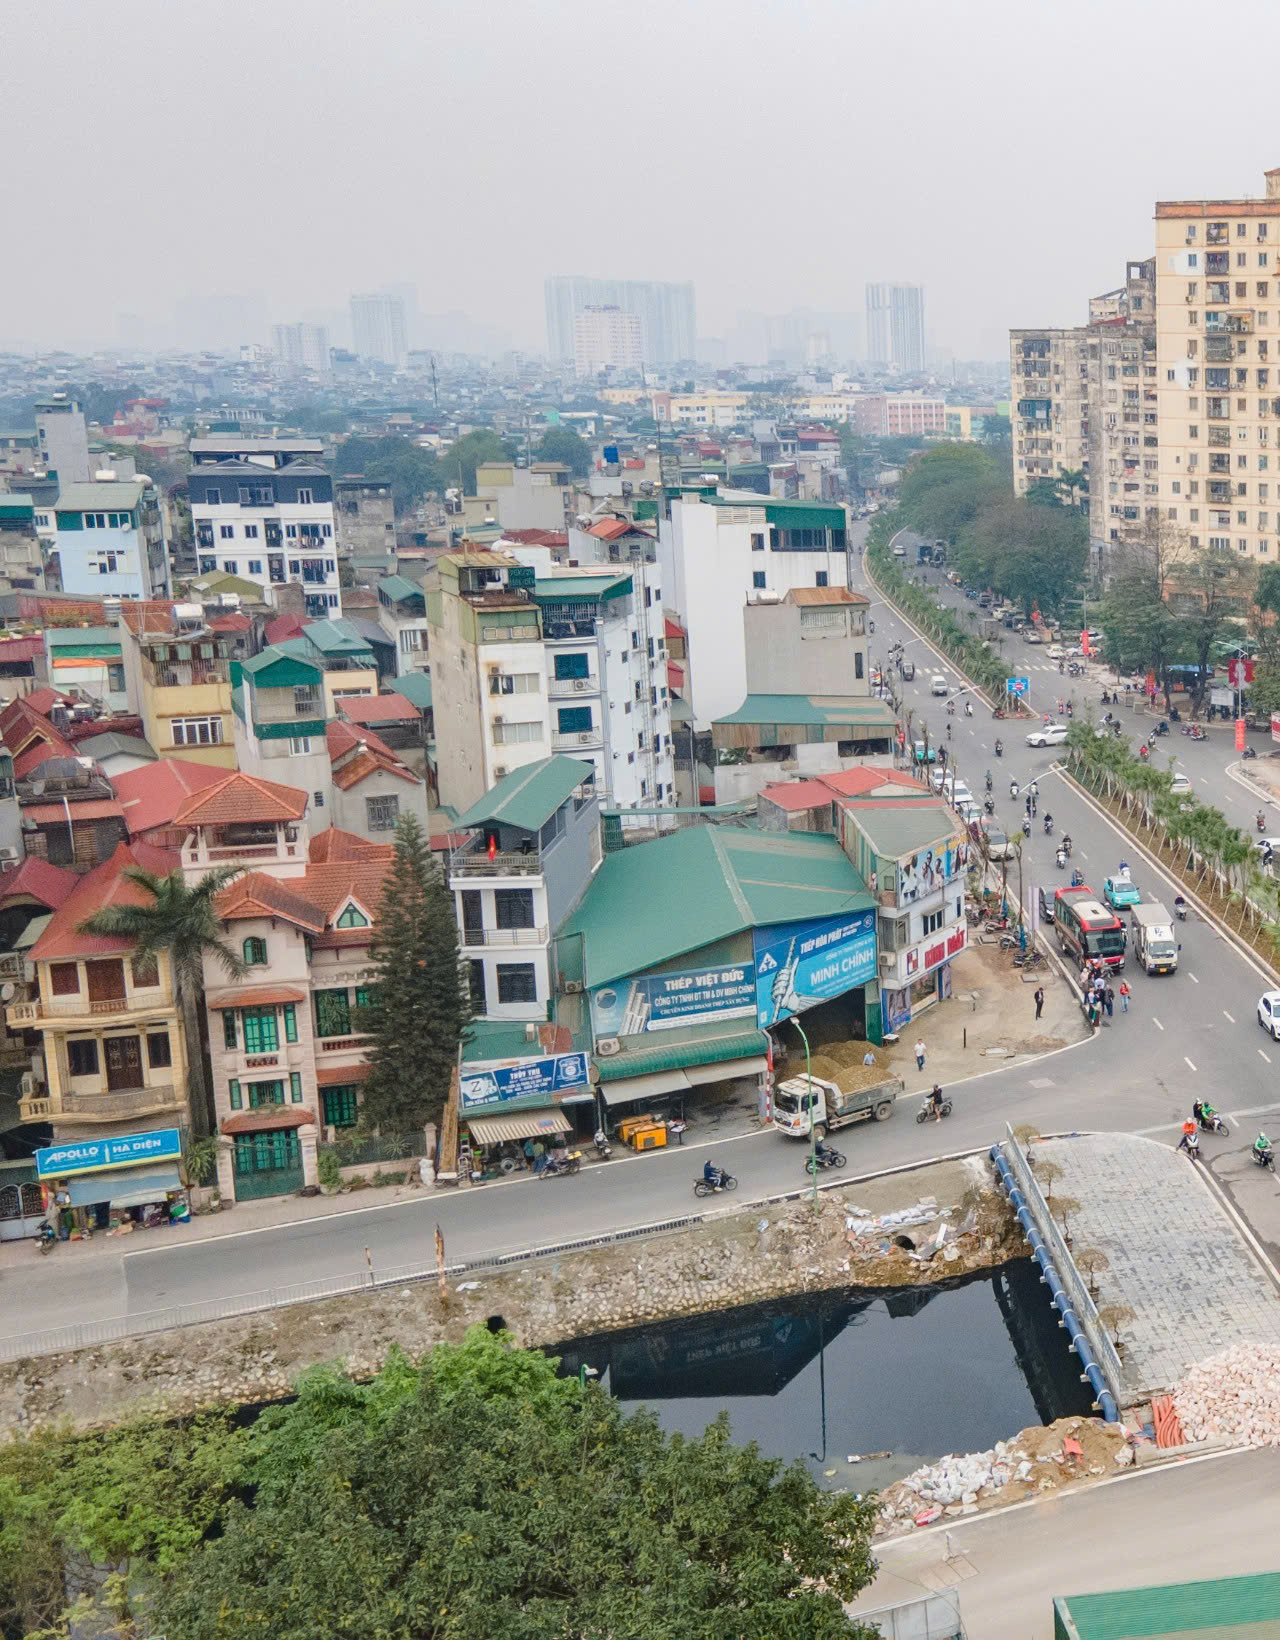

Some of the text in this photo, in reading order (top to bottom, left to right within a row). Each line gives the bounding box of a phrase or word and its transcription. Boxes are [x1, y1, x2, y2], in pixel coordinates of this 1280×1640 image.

[800, 938, 816, 955] THÉP
[810, 962, 840, 987] MINH
[841, 947, 874, 972] CHÍNH
[664, 968, 745, 992] THÉP VIỆT ĐỨC
[44, 1146, 99, 1165] APOLLO
[113, 1143, 131, 1154] HÀ
